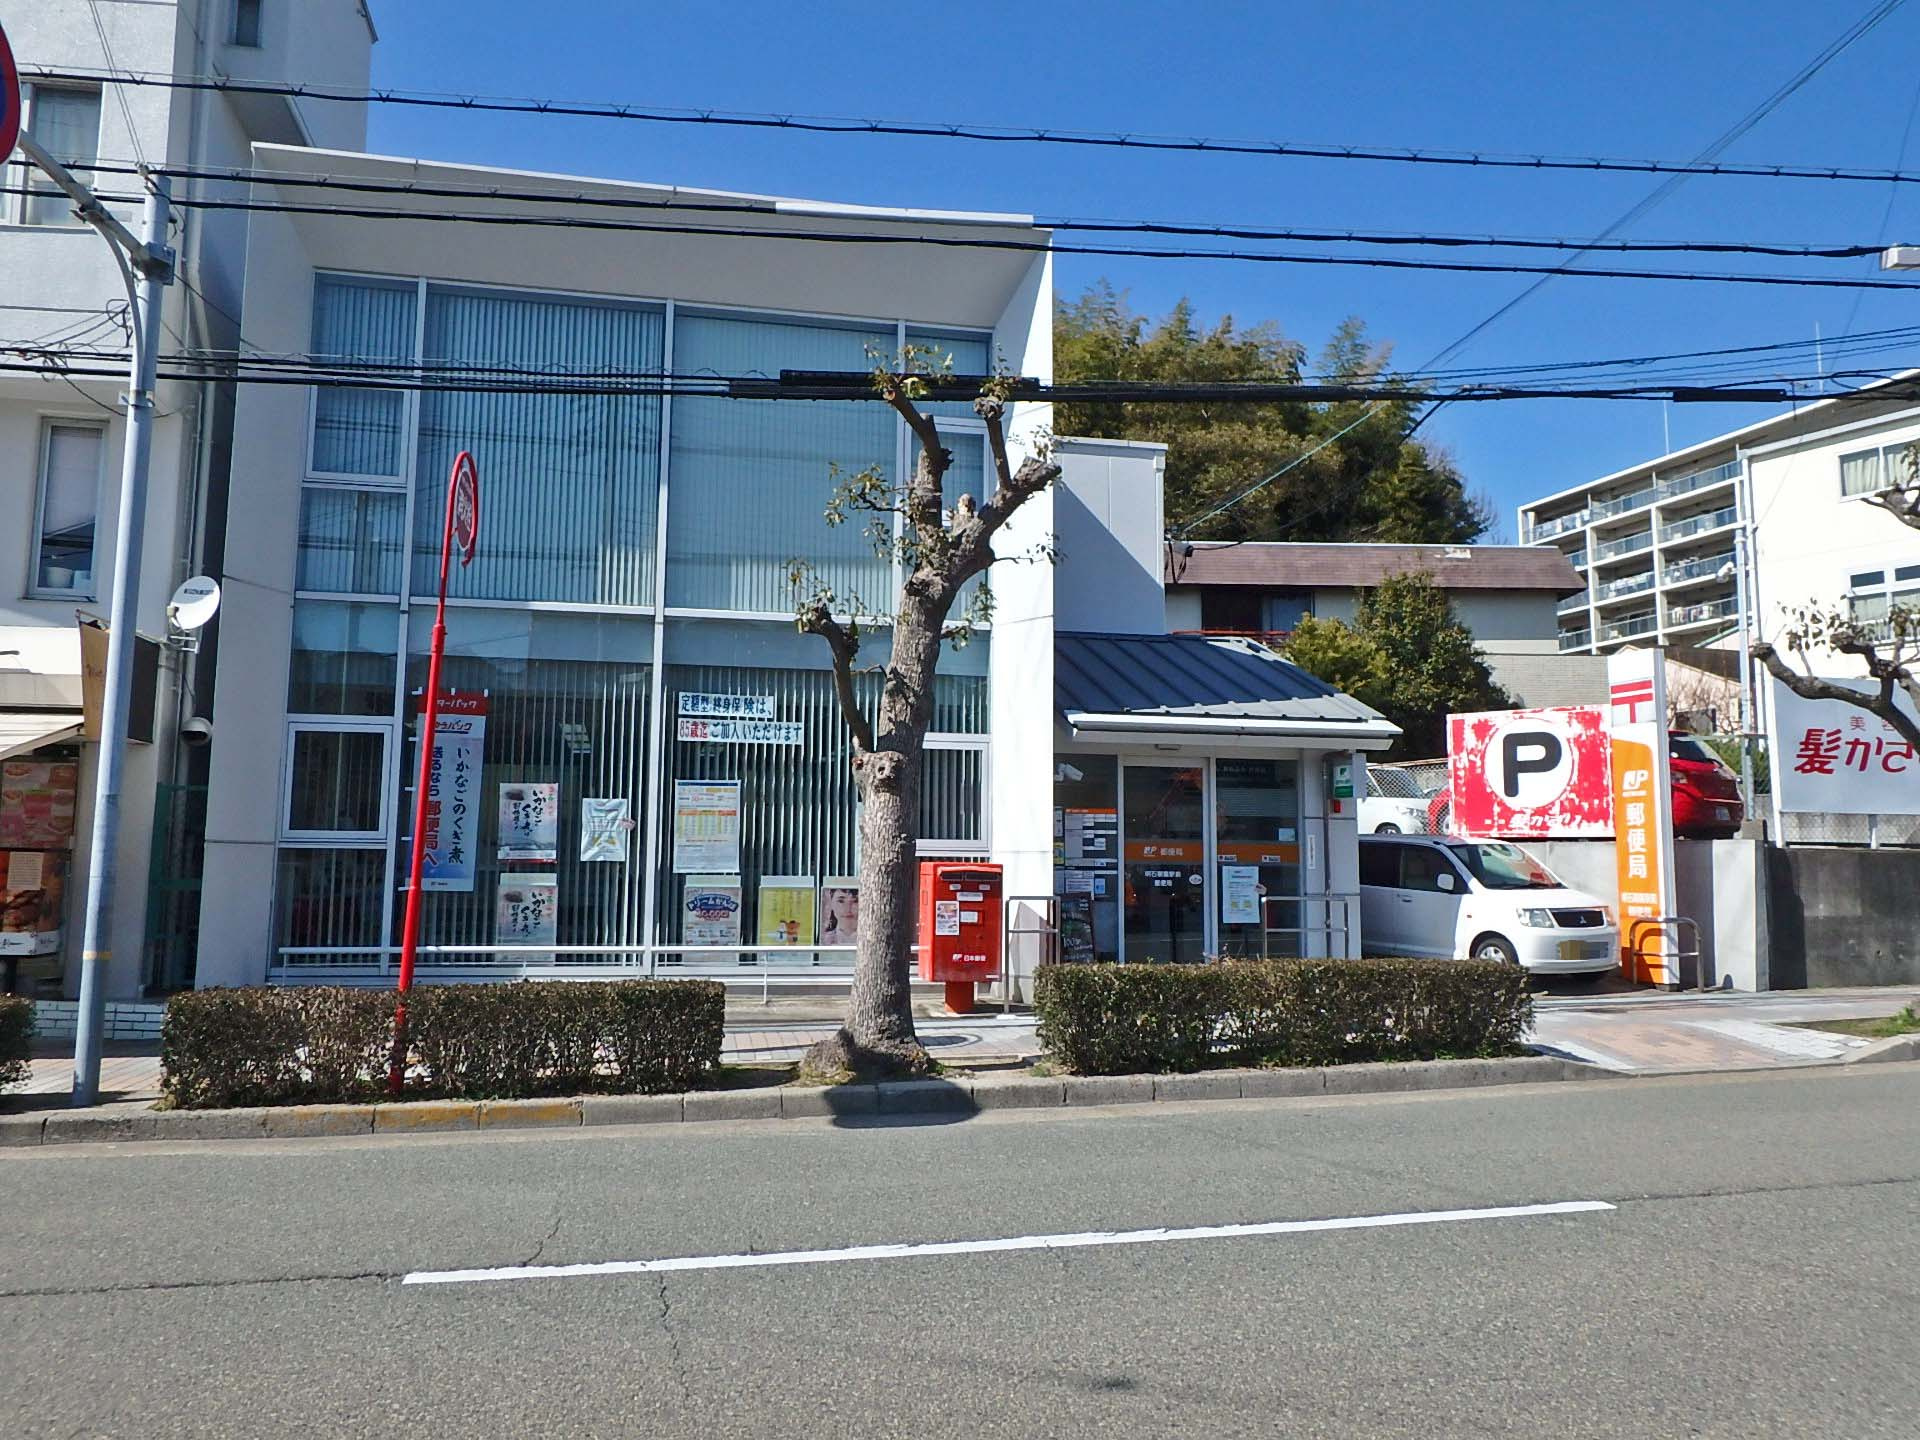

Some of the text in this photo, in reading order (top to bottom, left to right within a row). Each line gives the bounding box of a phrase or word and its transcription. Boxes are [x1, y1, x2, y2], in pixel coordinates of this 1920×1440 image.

[436, 699, 477, 709] ターパック
[681, 694, 772, 715] 定額型終身保険は、
[1503, 732, 1562, 797] P
[448, 747, 470, 865] いかなごのくぎ煮
[1626, 802, 1648, 878] 郵便局
